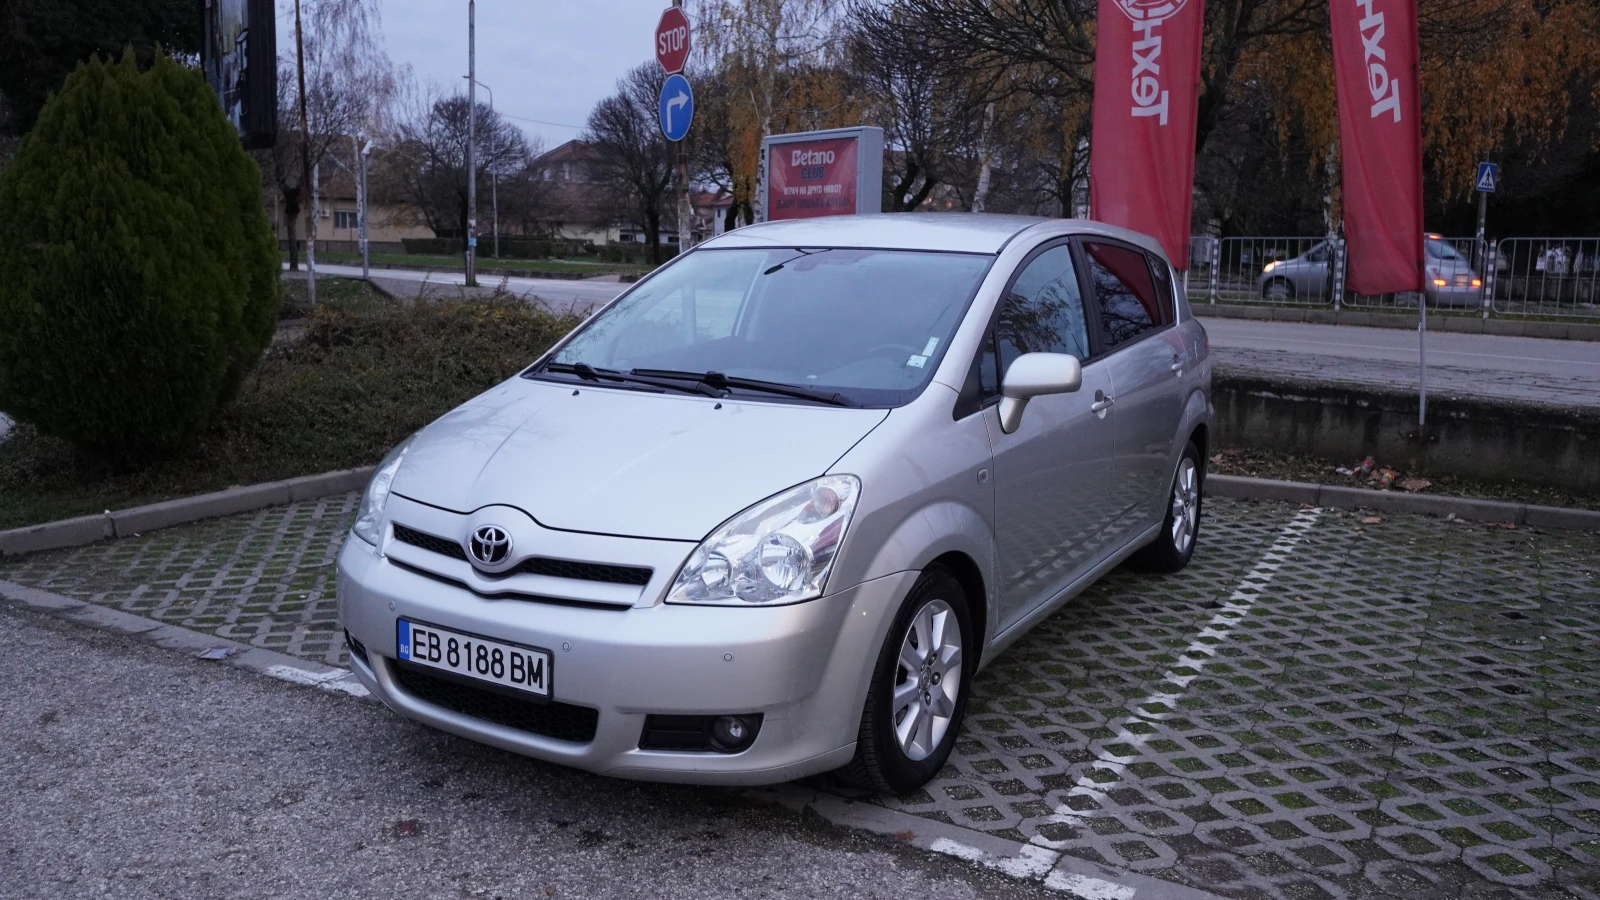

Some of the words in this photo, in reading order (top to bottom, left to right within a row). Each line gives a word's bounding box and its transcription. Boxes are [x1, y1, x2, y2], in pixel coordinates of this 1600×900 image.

[659, 26, 686, 55] STOP
[791, 150, 835, 166] Betano
[802, 167, 824, 179] CLUB
[808, 185, 822, 195] ДРУГО
[400, 643, 409, 655] BG
[413, 628, 442, 663] EB
[447, 637, 505, 679] 8188
[511, 651, 544, 690] BM
